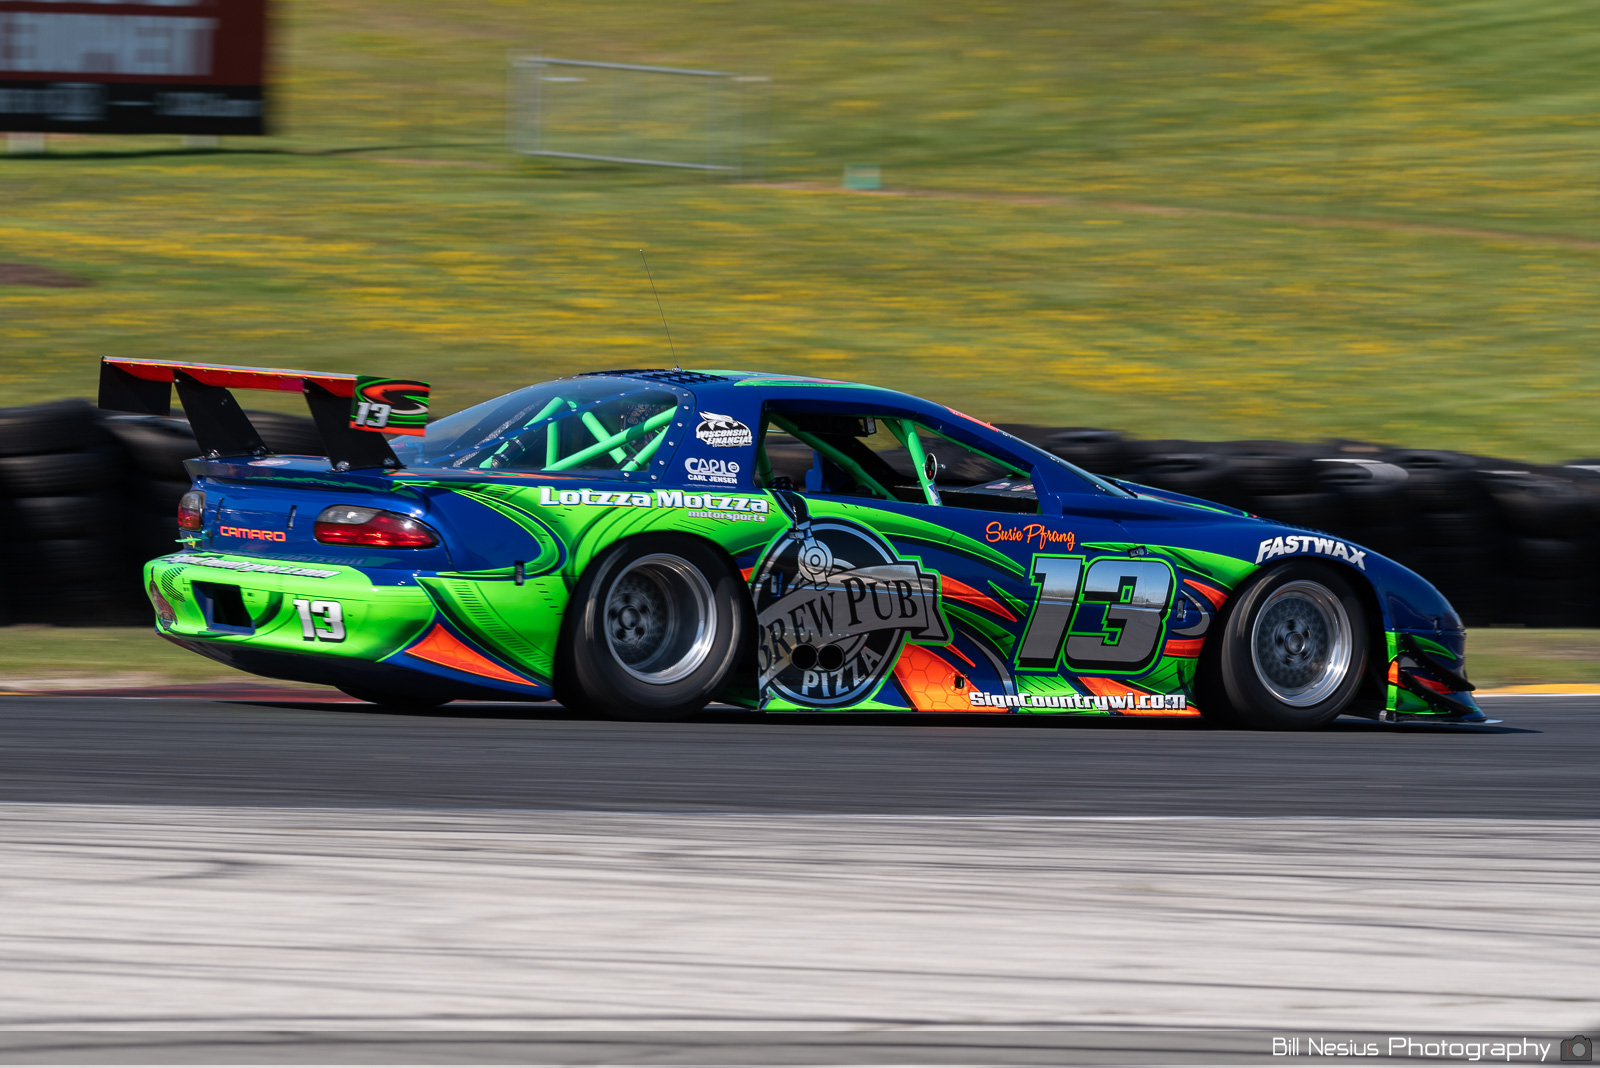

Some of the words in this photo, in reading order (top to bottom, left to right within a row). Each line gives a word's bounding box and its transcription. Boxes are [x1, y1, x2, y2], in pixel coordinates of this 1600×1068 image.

[355, 401, 392, 428] 13
[696, 429, 749, 439] WISCONSIN
[707, 436, 752, 445] FINANCIAL
[687, 474, 708, 482] CARL
[708, 476, 738, 485] JENSEN
[539, 487, 653, 509] Lotzza
[656, 489, 769, 513] Motzza
[688, 510, 766, 522] motorsports
[219, 525, 287, 542] CAMARO
[985, 521, 1023, 543] Susie
[1023, 523, 1076, 551] Pfrang
[1254, 534, 1368, 572] FASTWAX
[840, 576, 919, 628] PUB
[1014, 553, 1178, 675] 13
[293, 598, 346, 643] 13
[801, 646, 883, 698] PIZZA
[968, 691, 1187, 711] SignCountrywi.com
